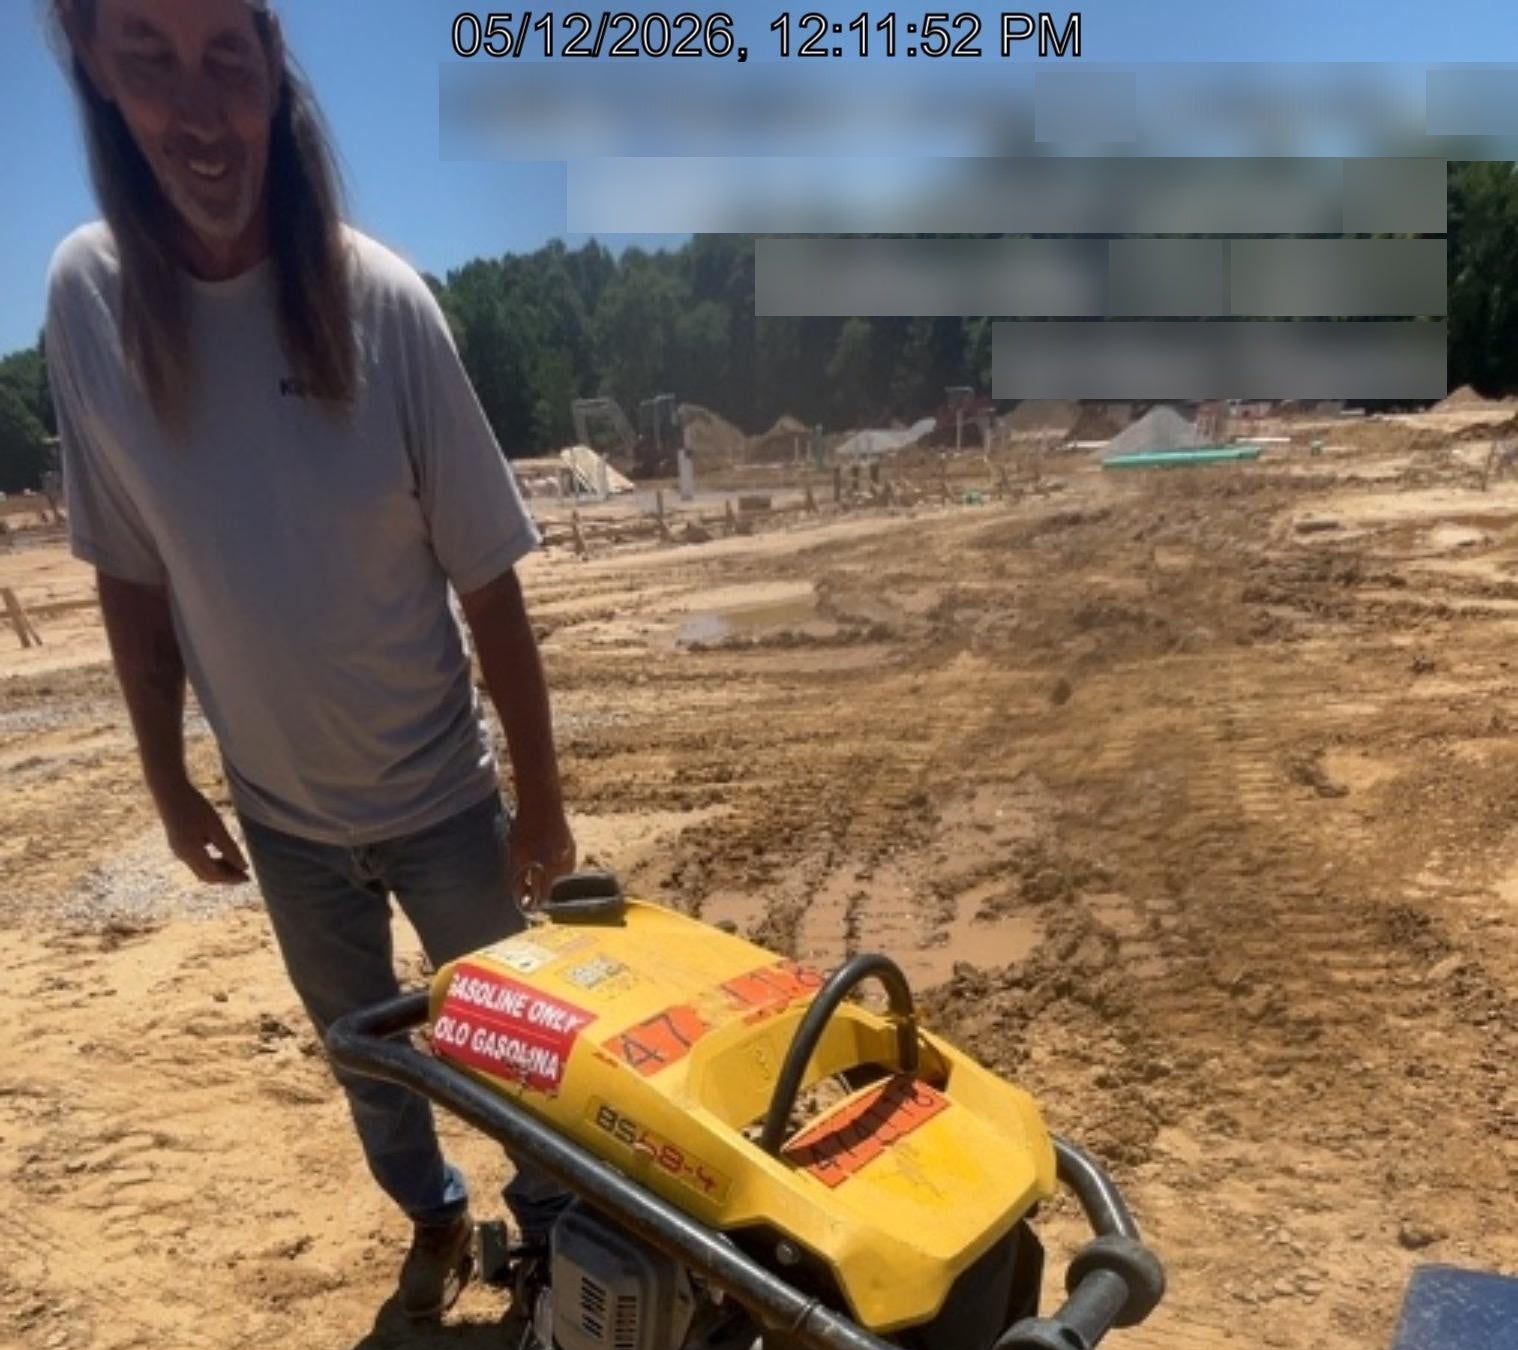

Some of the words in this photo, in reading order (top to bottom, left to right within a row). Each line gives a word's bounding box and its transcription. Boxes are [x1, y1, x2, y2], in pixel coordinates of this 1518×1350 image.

[528, 999, 587, 1033] ONLY
[434, 1016, 468, 1045] OLO
[471, 1028, 560, 1081] GASOLINA
